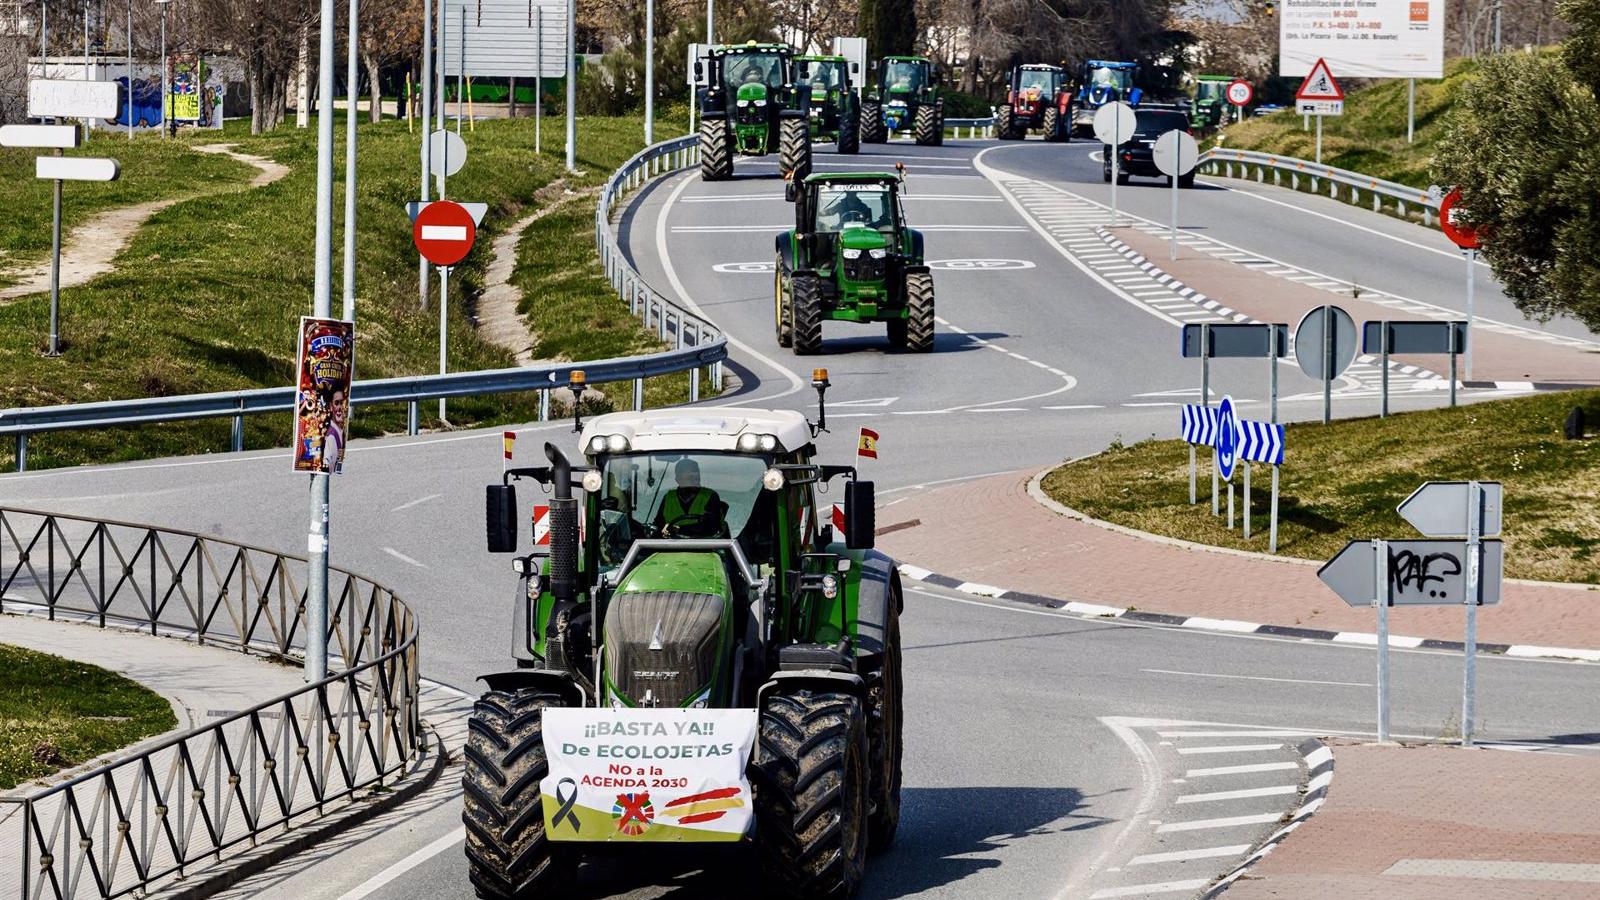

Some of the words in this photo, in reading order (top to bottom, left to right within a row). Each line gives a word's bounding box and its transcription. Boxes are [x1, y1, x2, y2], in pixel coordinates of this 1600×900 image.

[1232, 89, 1247, 97] 70
[584, 721, 668, 738] ¡¡BASTA
[674, 721, 715, 737] YA!!
[562, 743, 589, 757] De
[597, 743, 734, 759] ECOLOJETAS
[608, 763, 632, 776] NO
[636, 766, 645, 776] a
[650, 765, 663, 776] la
[580, 775, 647, 788] AGENDA
[652, 777, 688, 788] 2030
